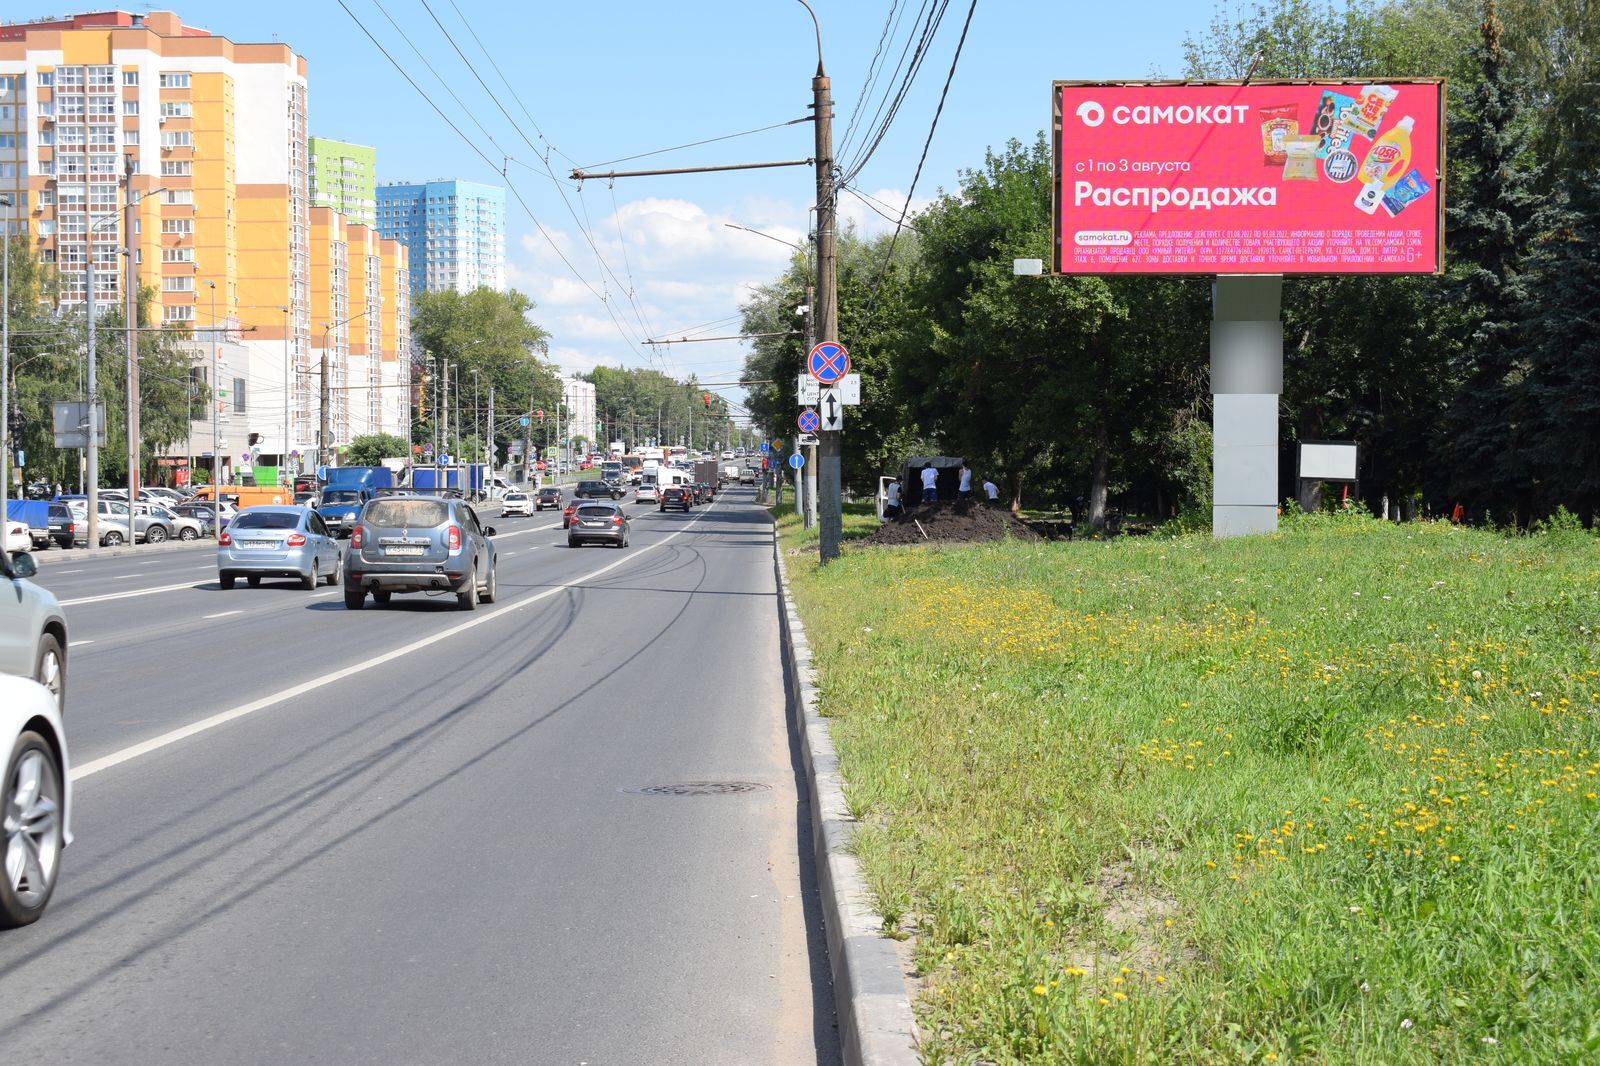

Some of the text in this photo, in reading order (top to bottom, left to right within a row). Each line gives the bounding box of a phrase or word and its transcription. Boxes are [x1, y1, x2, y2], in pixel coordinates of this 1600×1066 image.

[1112, 104, 1250, 125] самокат
[1088, 159, 1093, 172] 1
[1097, 162, 1116, 172] по
[1119, 159, 1129, 172] 3
[1131, 162, 1191, 175] августа
[1074, 181, 1277, 213] Распродажа
[1078, 233, 1129, 241] samokat.ru
[1406, 247, 1423, 263] 6+
